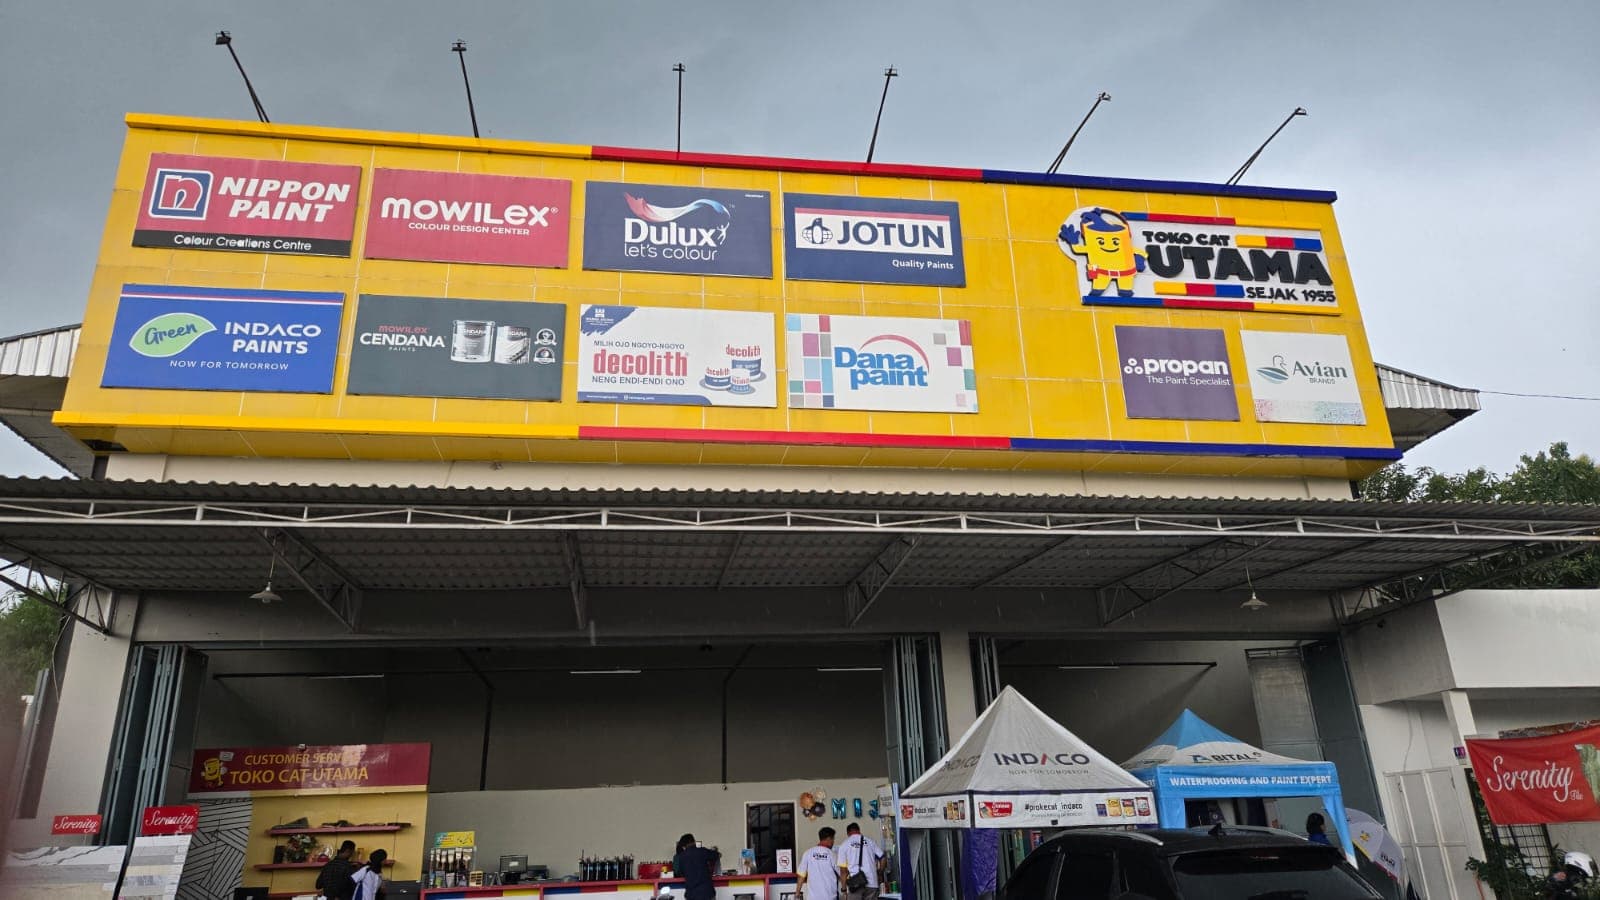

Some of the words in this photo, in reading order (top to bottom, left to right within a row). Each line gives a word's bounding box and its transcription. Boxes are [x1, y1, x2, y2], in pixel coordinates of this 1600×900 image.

[218, 177, 351, 202] NIPPON
[228, 199, 334, 223] PAINT
[408, 222, 450, 231] COLOUR
[452, 224, 489, 234] DESIGN
[491, 226, 530, 236] CENTER
[624, 218, 717, 247] Dulux
[837, 221, 945, 249] JOTUN
[174, 234, 213, 247] Colour
[216, 235, 271, 249] Creations
[273, 238, 312, 251] Centre
[1142, 230, 1193, 246] TOKO
[1195, 233, 1230, 246] CAT
[624, 243, 657, 258] let's
[663, 247, 718, 261] colour
[892, 259, 925, 269] Quality
[927, 261, 954, 270] Paints
[1146, 245, 1334, 286] UTAMA
[1246, 286, 1298, 301] SEJAK
[1302, 289, 1336, 302] 1955
[144, 322, 198, 345] Green
[224, 321, 322, 338] INDACO
[232, 339, 308, 354] PAINTS
[359, 332, 446, 348] CENDANA
[631, 342, 685, 350] NGOYO-NGOYO
[169, 360, 197, 368] NOW
[200, 361, 222, 369] FOR
[225, 361, 289, 371] TOMORROW
[593, 348, 688, 376] decolith
[834, 346, 915, 369] Dana
[1143, 358, 1229, 377] propan
[1293, 360, 1348, 378] Avian
[592, 376, 617, 384] NENG
[619, 376, 664, 385] ENDI-ENDI
[665, 378, 685, 386] ONO
[851, 366, 928, 390] paint
[1147, 376, 1163, 385] The
[1165, 376, 1188, 385] Paint
[1189, 376, 1231, 386] Specialist
[244, 753, 310, 766] CUSTOMER
[994, 753, 1091, 766] INDACO
[230, 769, 274, 785] TOKO
[278, 768, 307, 783] CAT
[312, 767, 369, 782] UTAMA
[1170, 776, 1247, 786] WATERPROOFING
[1250, 776, 1270, 785] AND
[1271, 776, 1298, 785] PAINT
[1300, 775, 1332, 785] EXPERT
[1486, 755, 1574, 802] Serenity
[54, 817, 97, 833] Serenity
